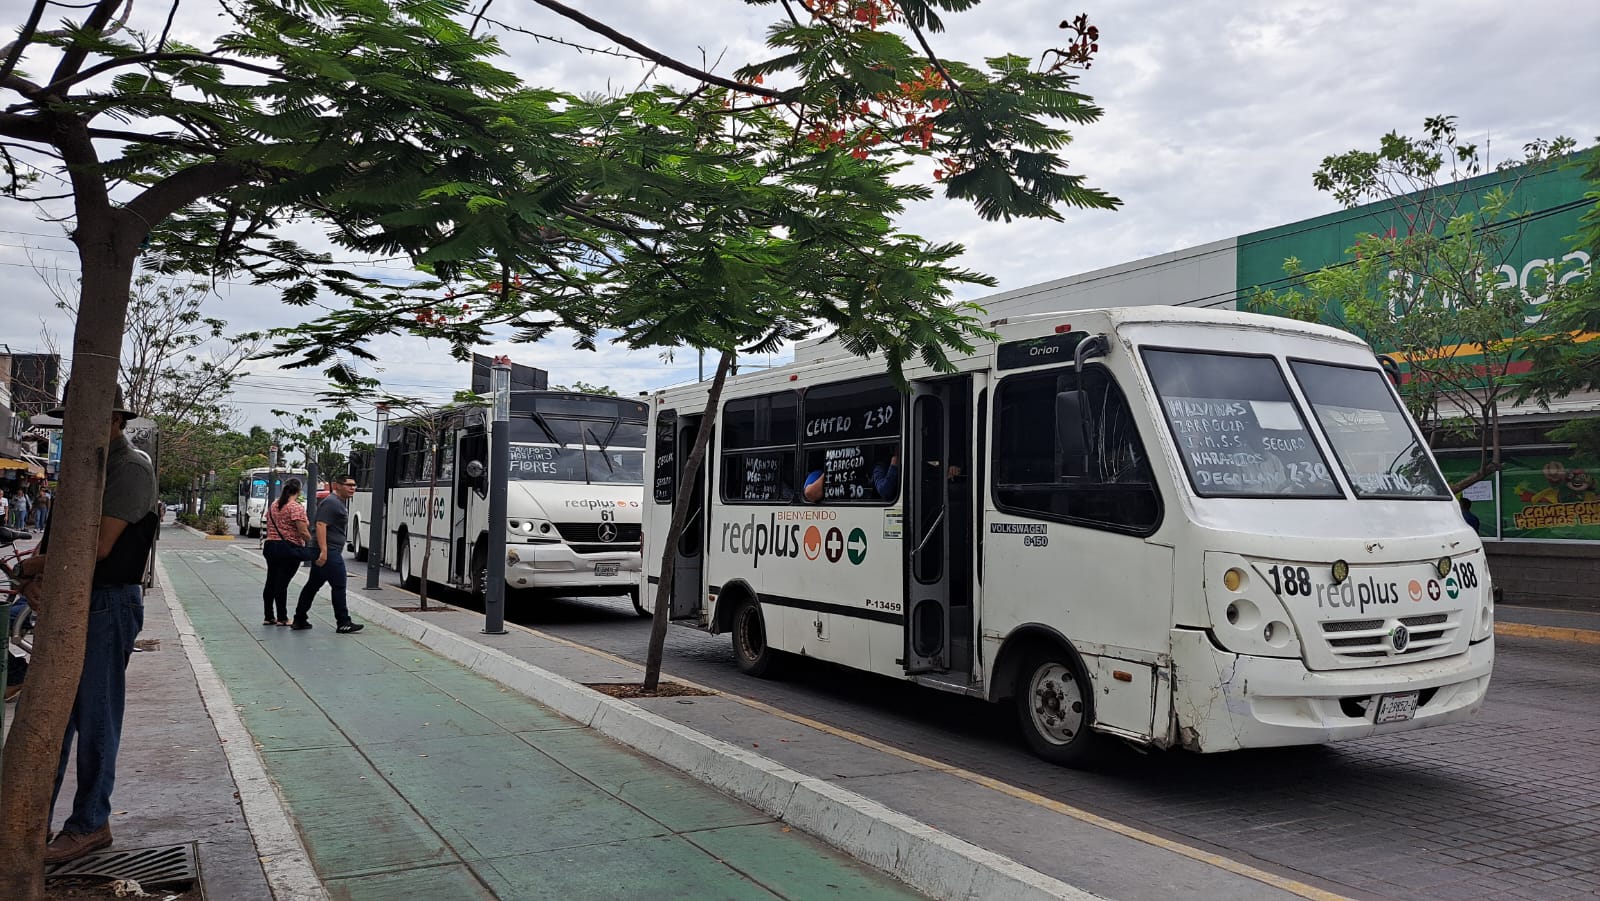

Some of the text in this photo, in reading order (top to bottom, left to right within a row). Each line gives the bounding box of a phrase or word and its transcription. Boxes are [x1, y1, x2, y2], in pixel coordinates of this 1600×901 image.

[1029, 346, 1059, 356] Orion
[806, 416, 851, 437] CENTRO
[565, 499, 615, 510] redplus
[601, 510, 615, 521] 61
[777, 510, 837, 521] BIENVENIDO
[1516, 515, 1574, 529] PRECIOS
[991, 523, 1047, 534] VOLKSWAGEN
[721, 512, 800, 569] redplus
[1269, 565, 1312, 597] 188
[1453, 562, 1478, 589] 188
[1316, 576, 1399, 613] redplus
[866, 599, 901, 611] P-13459
